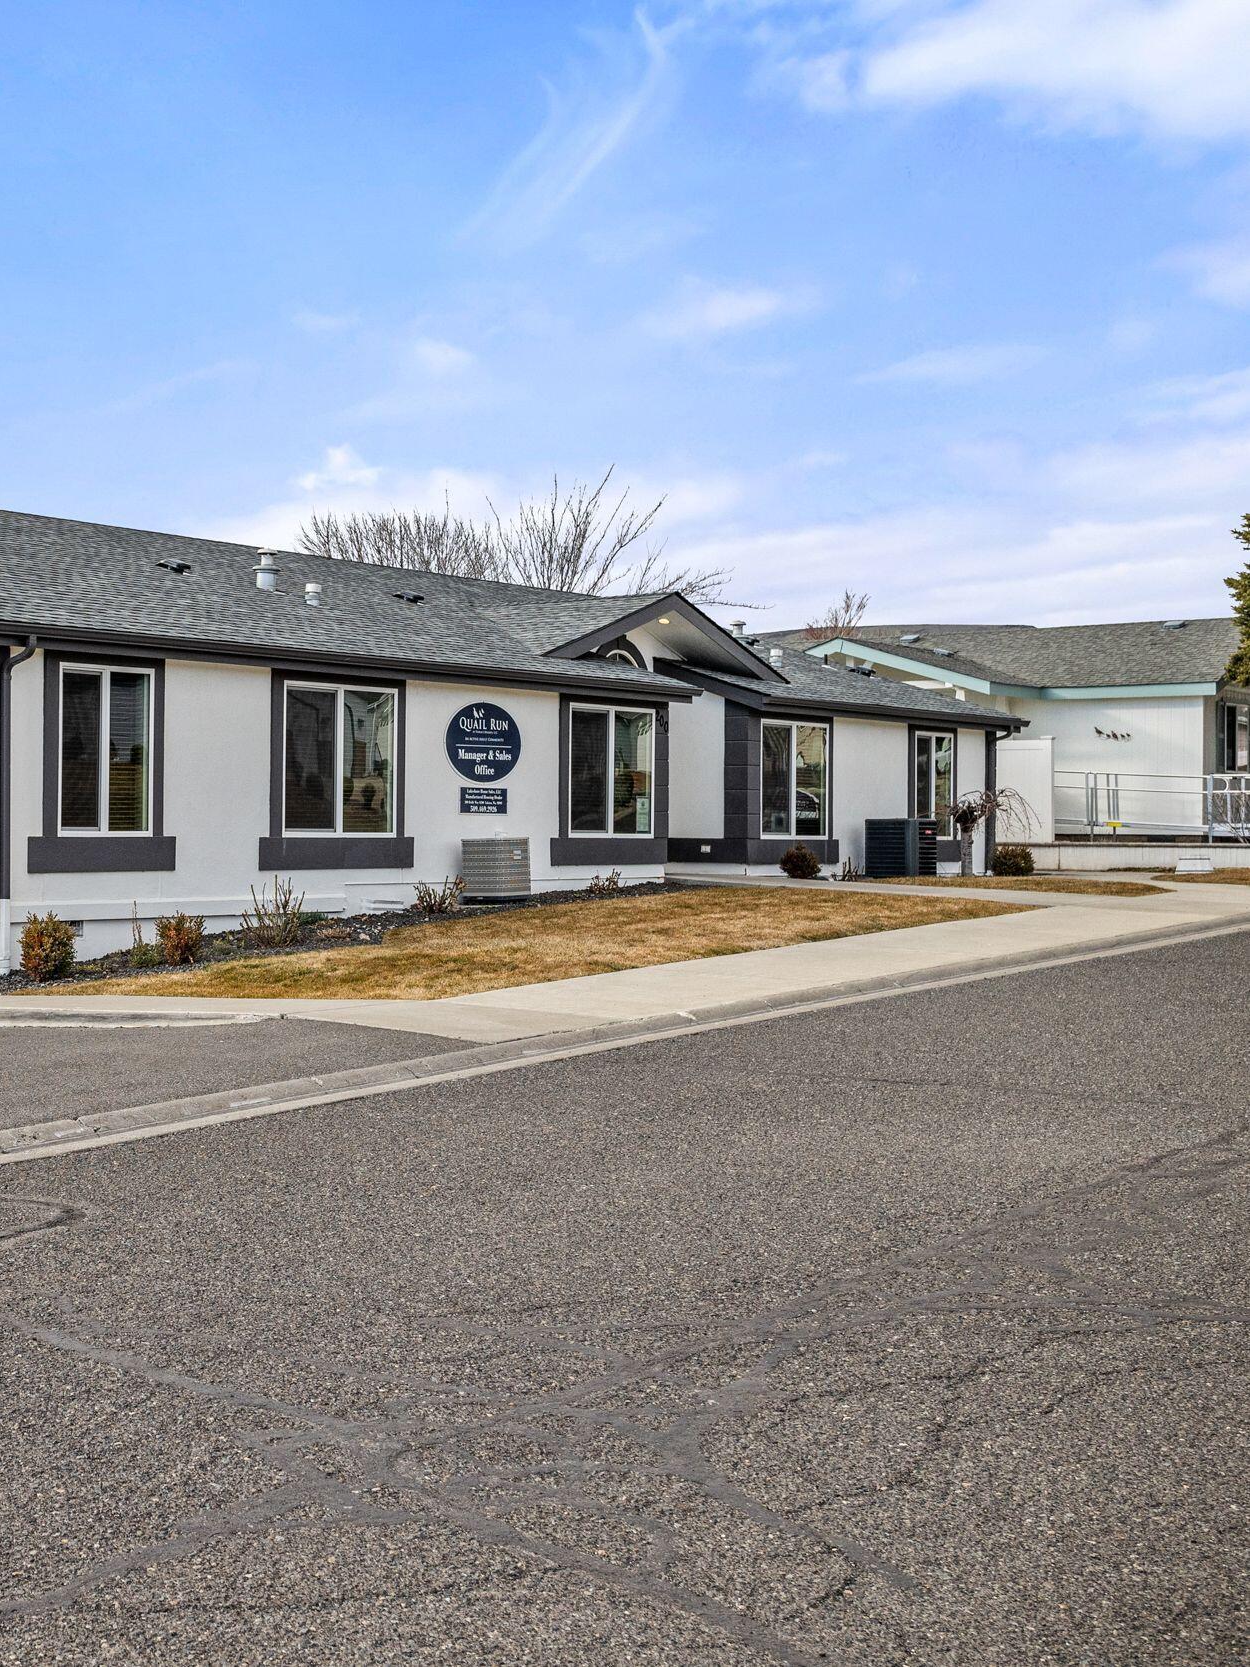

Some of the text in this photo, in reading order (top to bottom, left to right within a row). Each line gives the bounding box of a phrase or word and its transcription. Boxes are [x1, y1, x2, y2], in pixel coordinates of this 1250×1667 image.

[459, 717, 509, 732] QUAIL RUN
[656, 710, 668, 732] 200
[458, 749, 511, 762] Manager & Sales
[475, 765, 494, 775] Office
